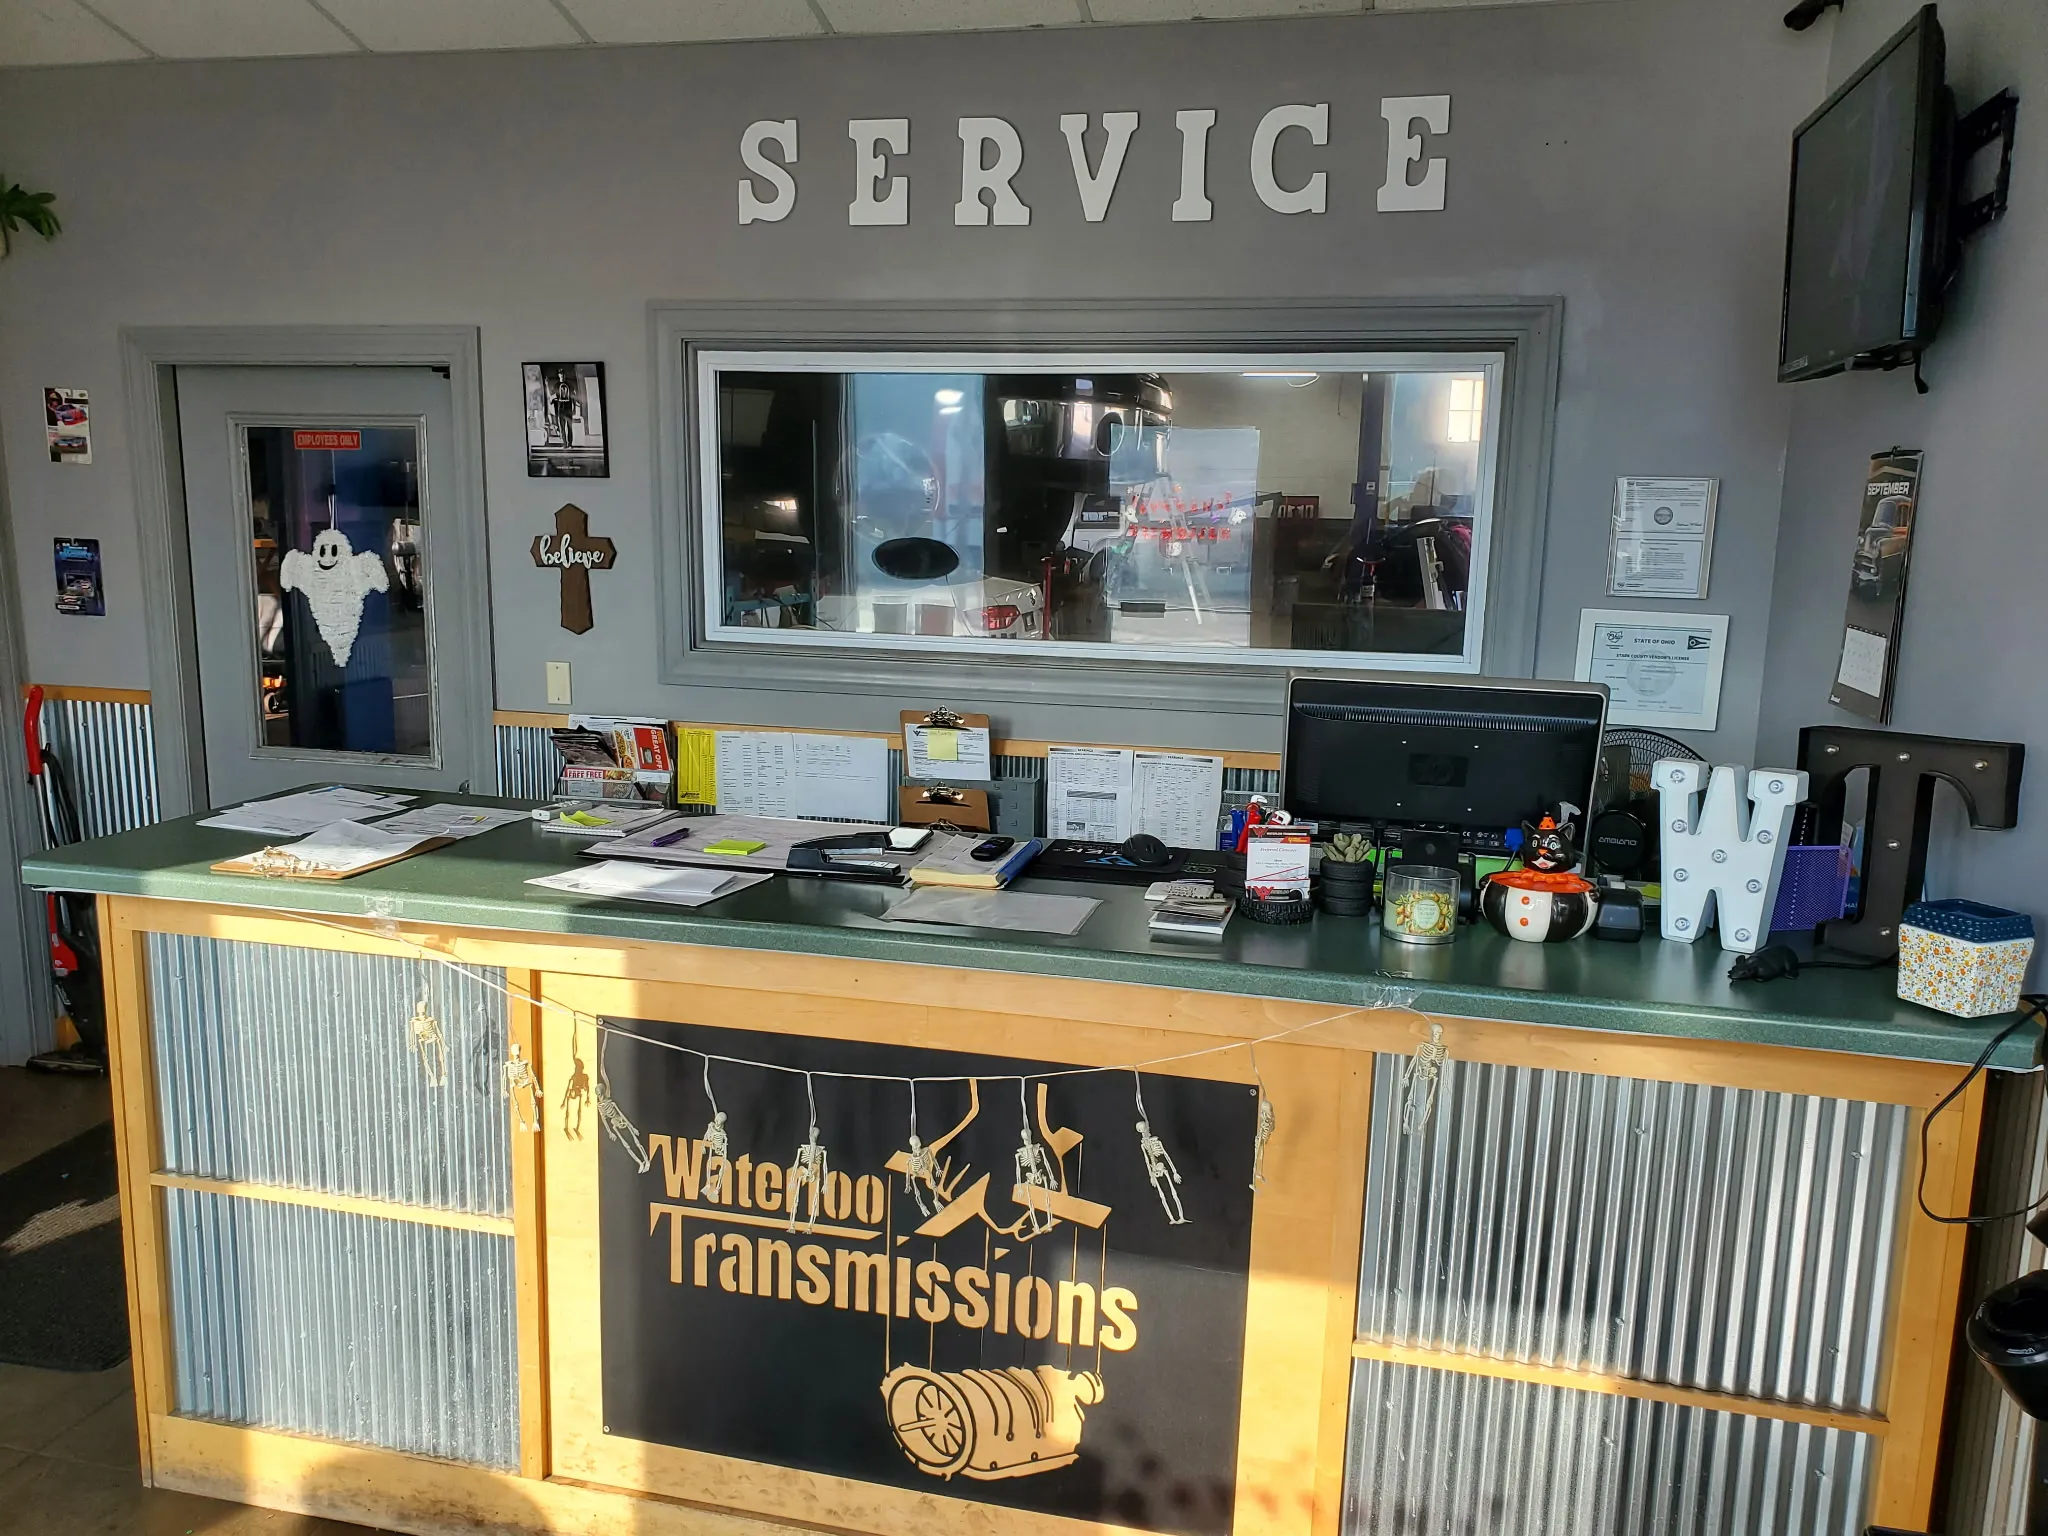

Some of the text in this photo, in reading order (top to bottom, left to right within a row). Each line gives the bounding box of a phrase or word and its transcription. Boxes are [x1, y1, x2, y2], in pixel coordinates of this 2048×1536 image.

[737, 94, 1451, 226] SERVICE
[297, 434, 358, 446] EMPLOYEES ONLY
[1867, 481, 1910, 496] SEPTEMBER
[539, 533, 604, 569] believe
[586, 770, 602, 779] FREE
[649, 1133, 884, 1224] Waterloo
[649, 1202, 1138, 1351] Transmissions
